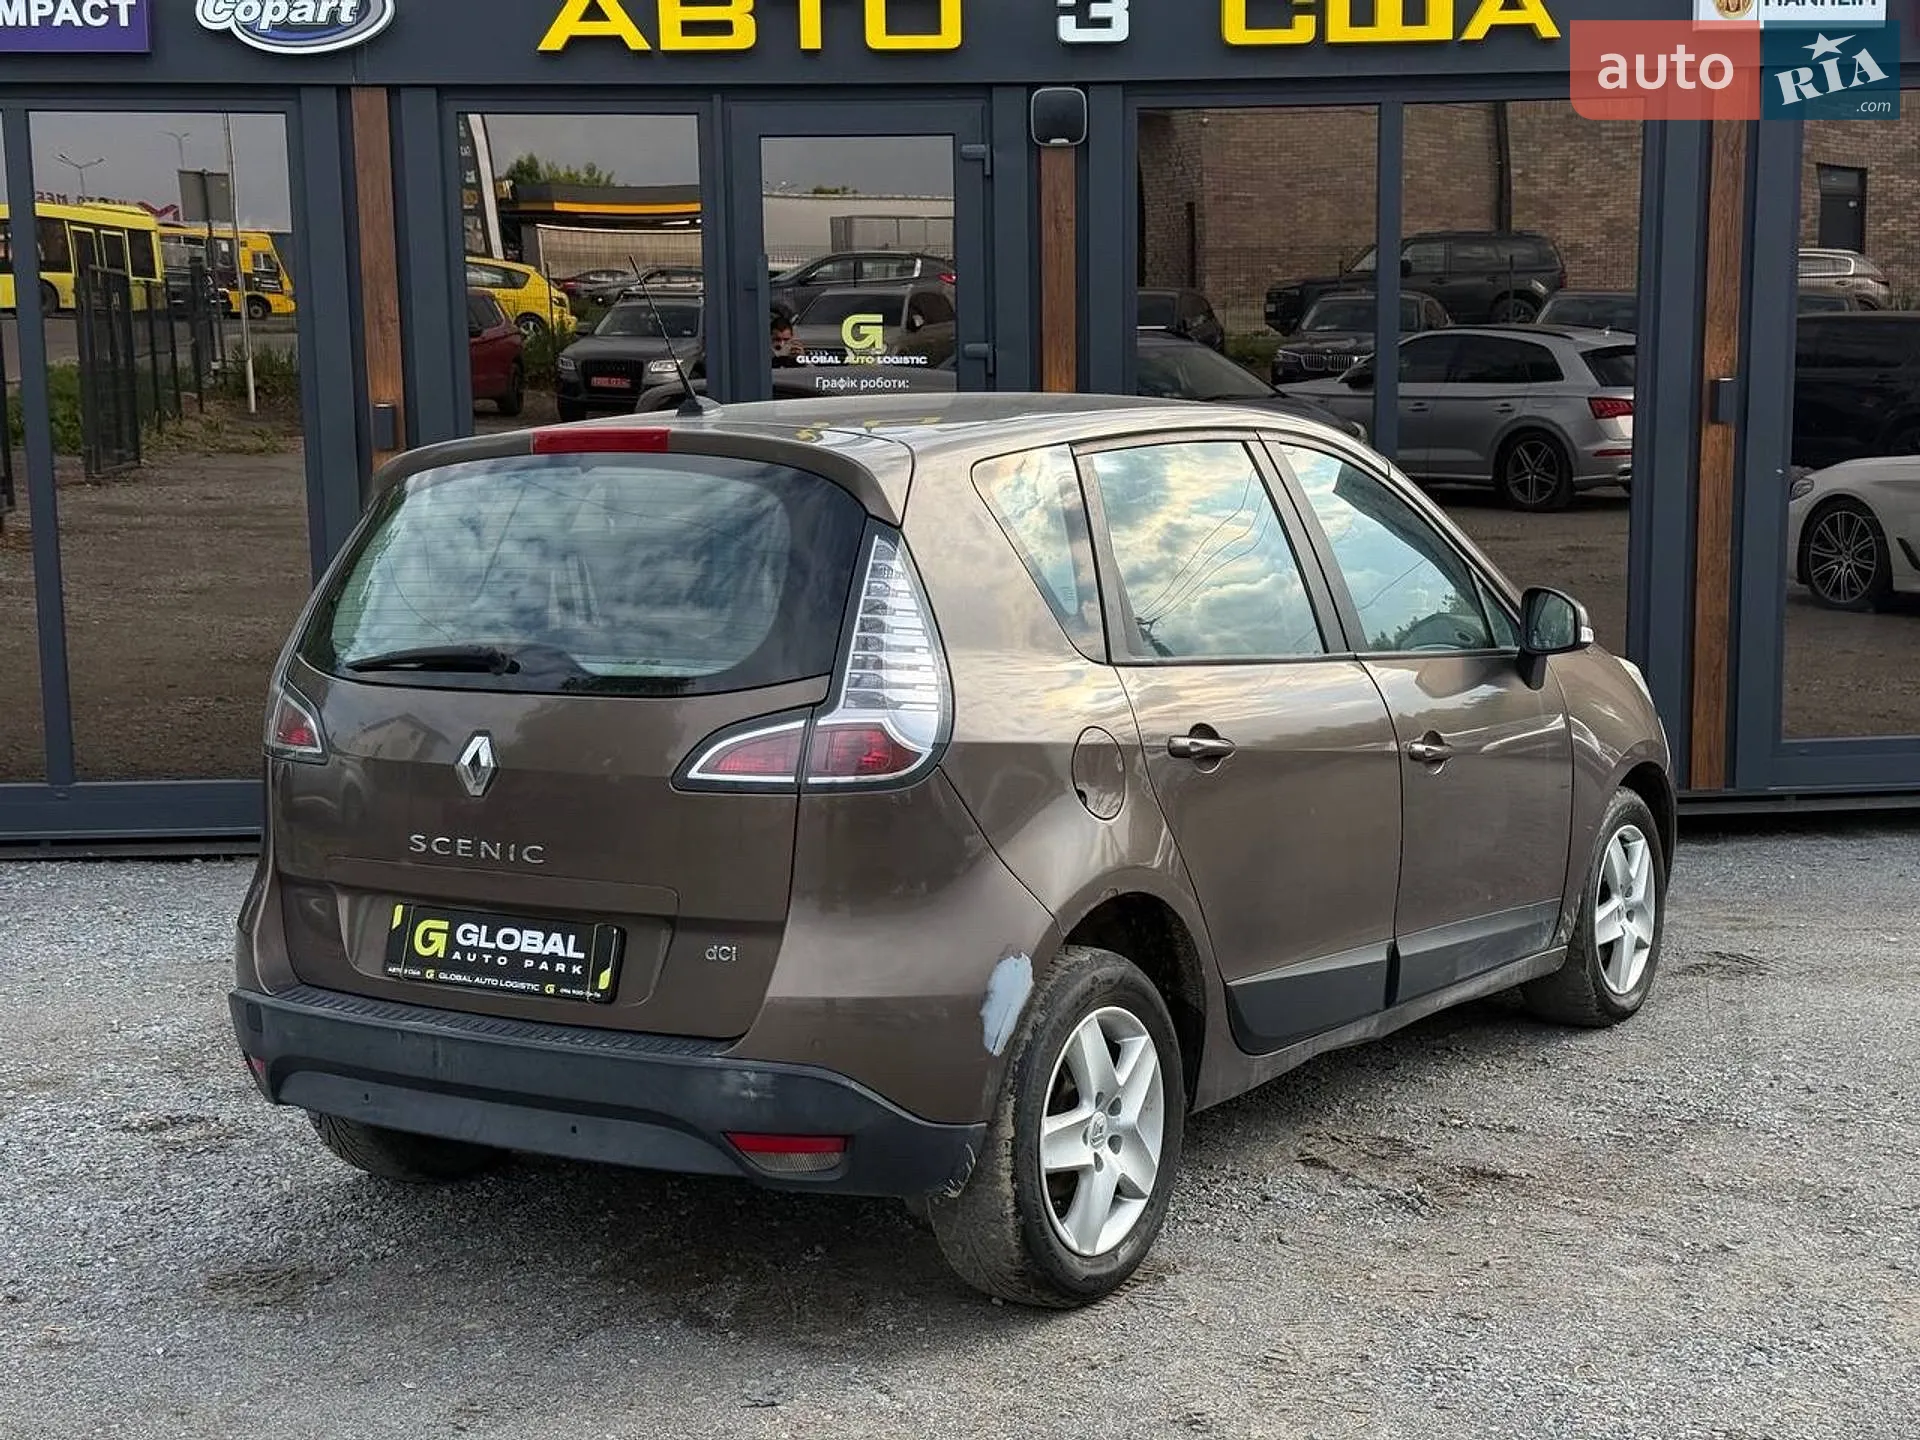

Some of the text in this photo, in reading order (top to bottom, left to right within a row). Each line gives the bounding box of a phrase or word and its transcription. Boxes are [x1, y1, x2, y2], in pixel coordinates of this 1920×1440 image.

[796, 355, 928, 365] GLOBAL AUTO LOGISTIC
[815, 376, 910, 391] Графік роботи:
[409, 834, 545, 864] SCENIC
[455, 922, 586, 960] GLOBAL
[451, 950, 583, 976] AUTO PARK
[438, 972, 473, 983] GLOBAL
[474, 976, 499, 986] AUTO
[499, 980, 541, 992] LOGISTIC
